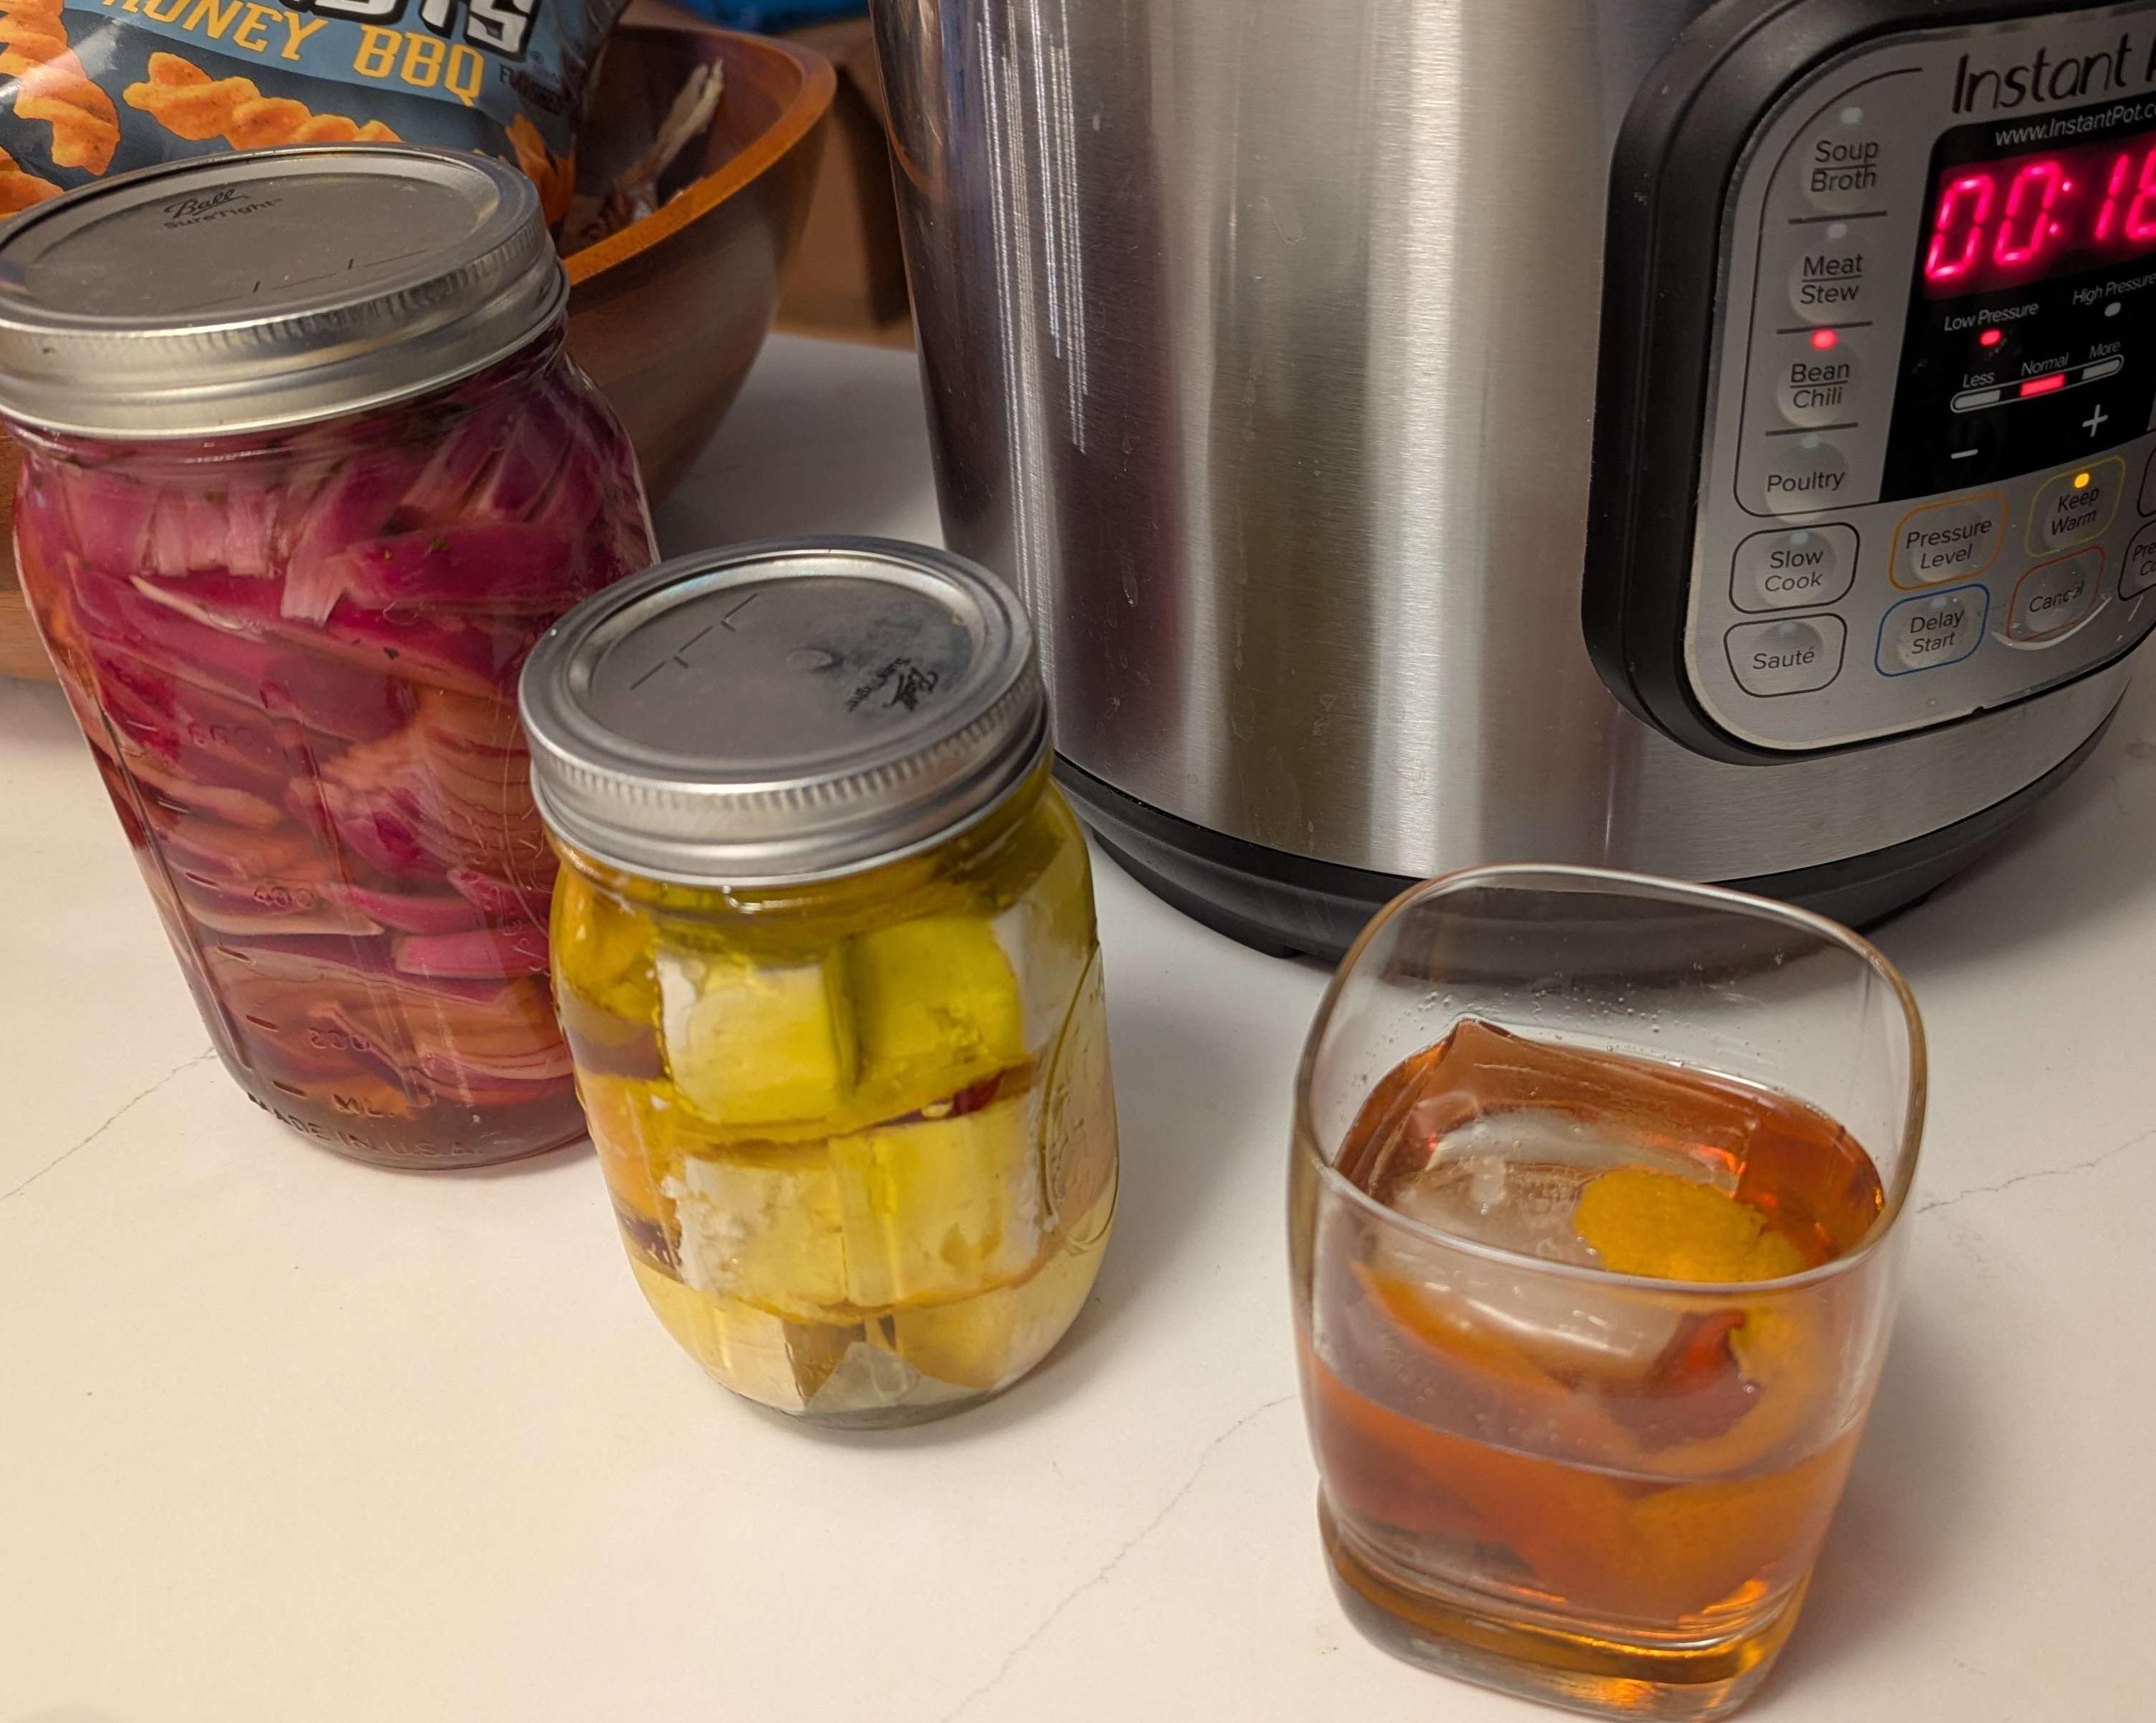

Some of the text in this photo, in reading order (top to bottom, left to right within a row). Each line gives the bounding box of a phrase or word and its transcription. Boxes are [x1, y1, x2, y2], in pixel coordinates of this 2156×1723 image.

[102, 0, 328, 61] ONEY
[354, 24, 485, 107] BBQ
[1951, 32, 2132, 114] Instant
[1995, 102, 2156, 146] www.InstantPot.c
[1815, 140, 1879, 164] Soup
[1810, 168, 1876, 193] Broth
[163, 188, 252, 219] Ball
[1802, 253, 1864, 277] Meat
[1800, 285, 1859, 305] Stew
[2073, 273, 2156, 305] High Pressure
[1944, 303, 2040, 331] Low Pressure
[2089, 340, 2121, 359] More
[1790, 362, 1850, 383] Bean
[2021, 352, 2069, 376] Normal
[1963, 372, 1995, 388] Less
[1792, 387, 1843, 410] Chili
[1766, 469, 1846, 493] Poultry
[2057, 487, 2100, 513] Keep
[1906, 519, 1993, 550] Pressure
[2052, 510, 2098, 536] Warm
[1770, 551, 1824, 569] Slow
[1920, 544, 1973, 570] Level
[1764, 572, 1823, 592] Cook
[2030, 579, 2085, 612] Cancel
[1909, 607, 1966, 635] Delay
[1912, 633, 1955, 654] Start
[1753, 645, 1816, 671] Sauté
